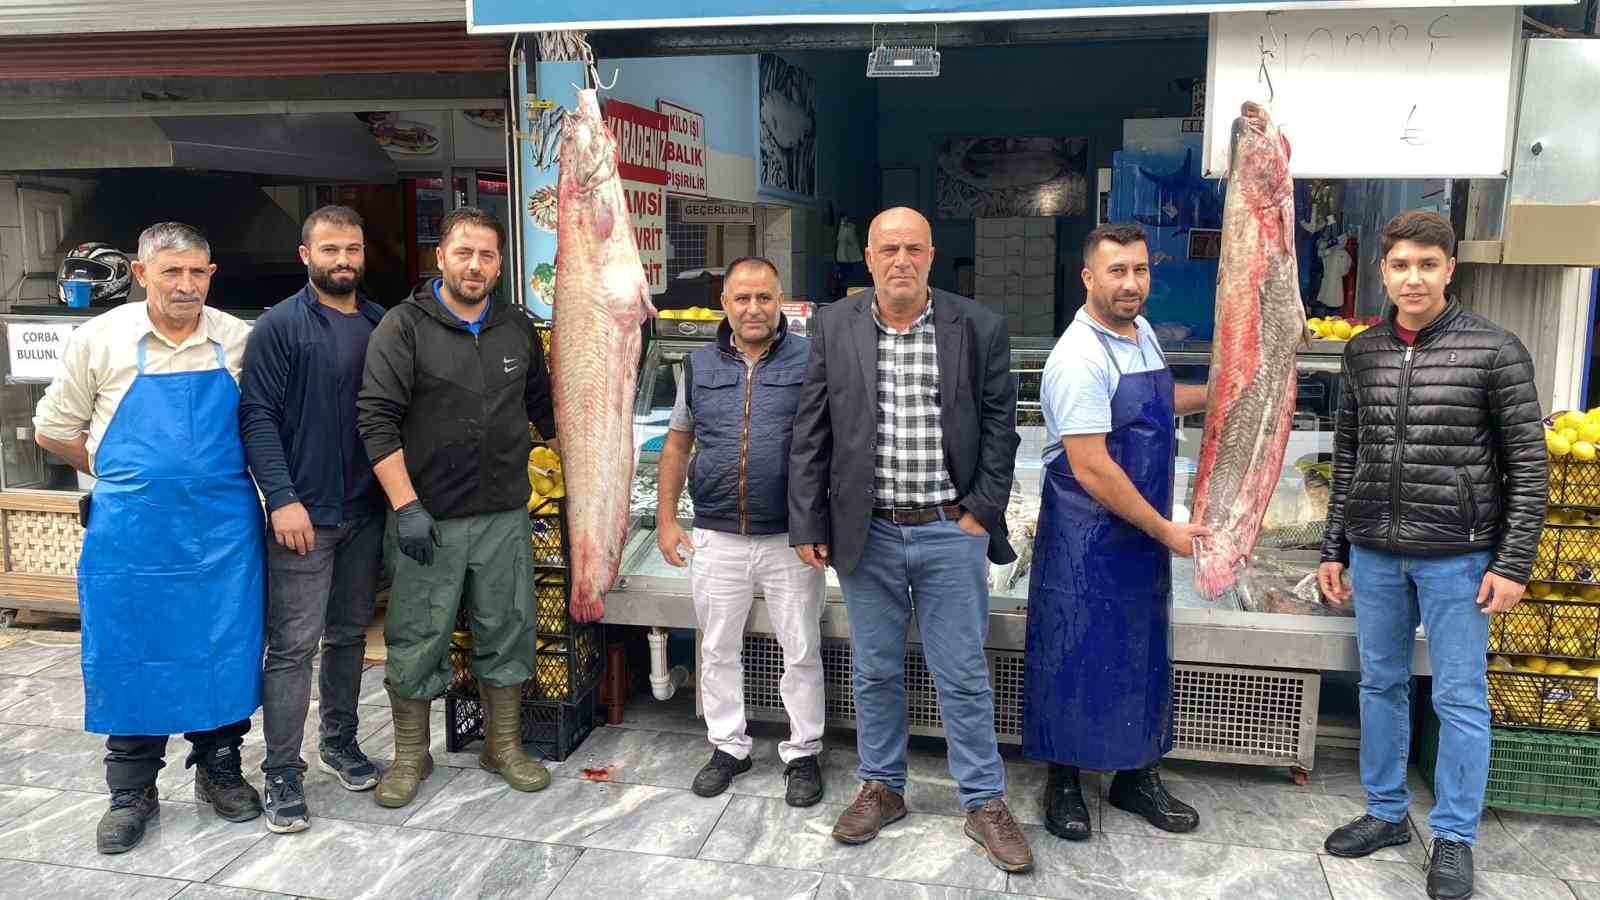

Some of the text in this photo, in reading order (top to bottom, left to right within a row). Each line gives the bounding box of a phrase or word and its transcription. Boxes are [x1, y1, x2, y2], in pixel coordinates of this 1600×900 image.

[670, 112, 688, 135] KİLO
[608, 115, 667, 169] KARADENİZ
[667, 141, 703, 167] BALIK
[666, 169, 705, 191] PİŞİRİLİR
[624, 187, 662, 218] AMSİ
[635, 223, 663, 250] VRİT
[22, 331, 60, 344] ÇORBA
